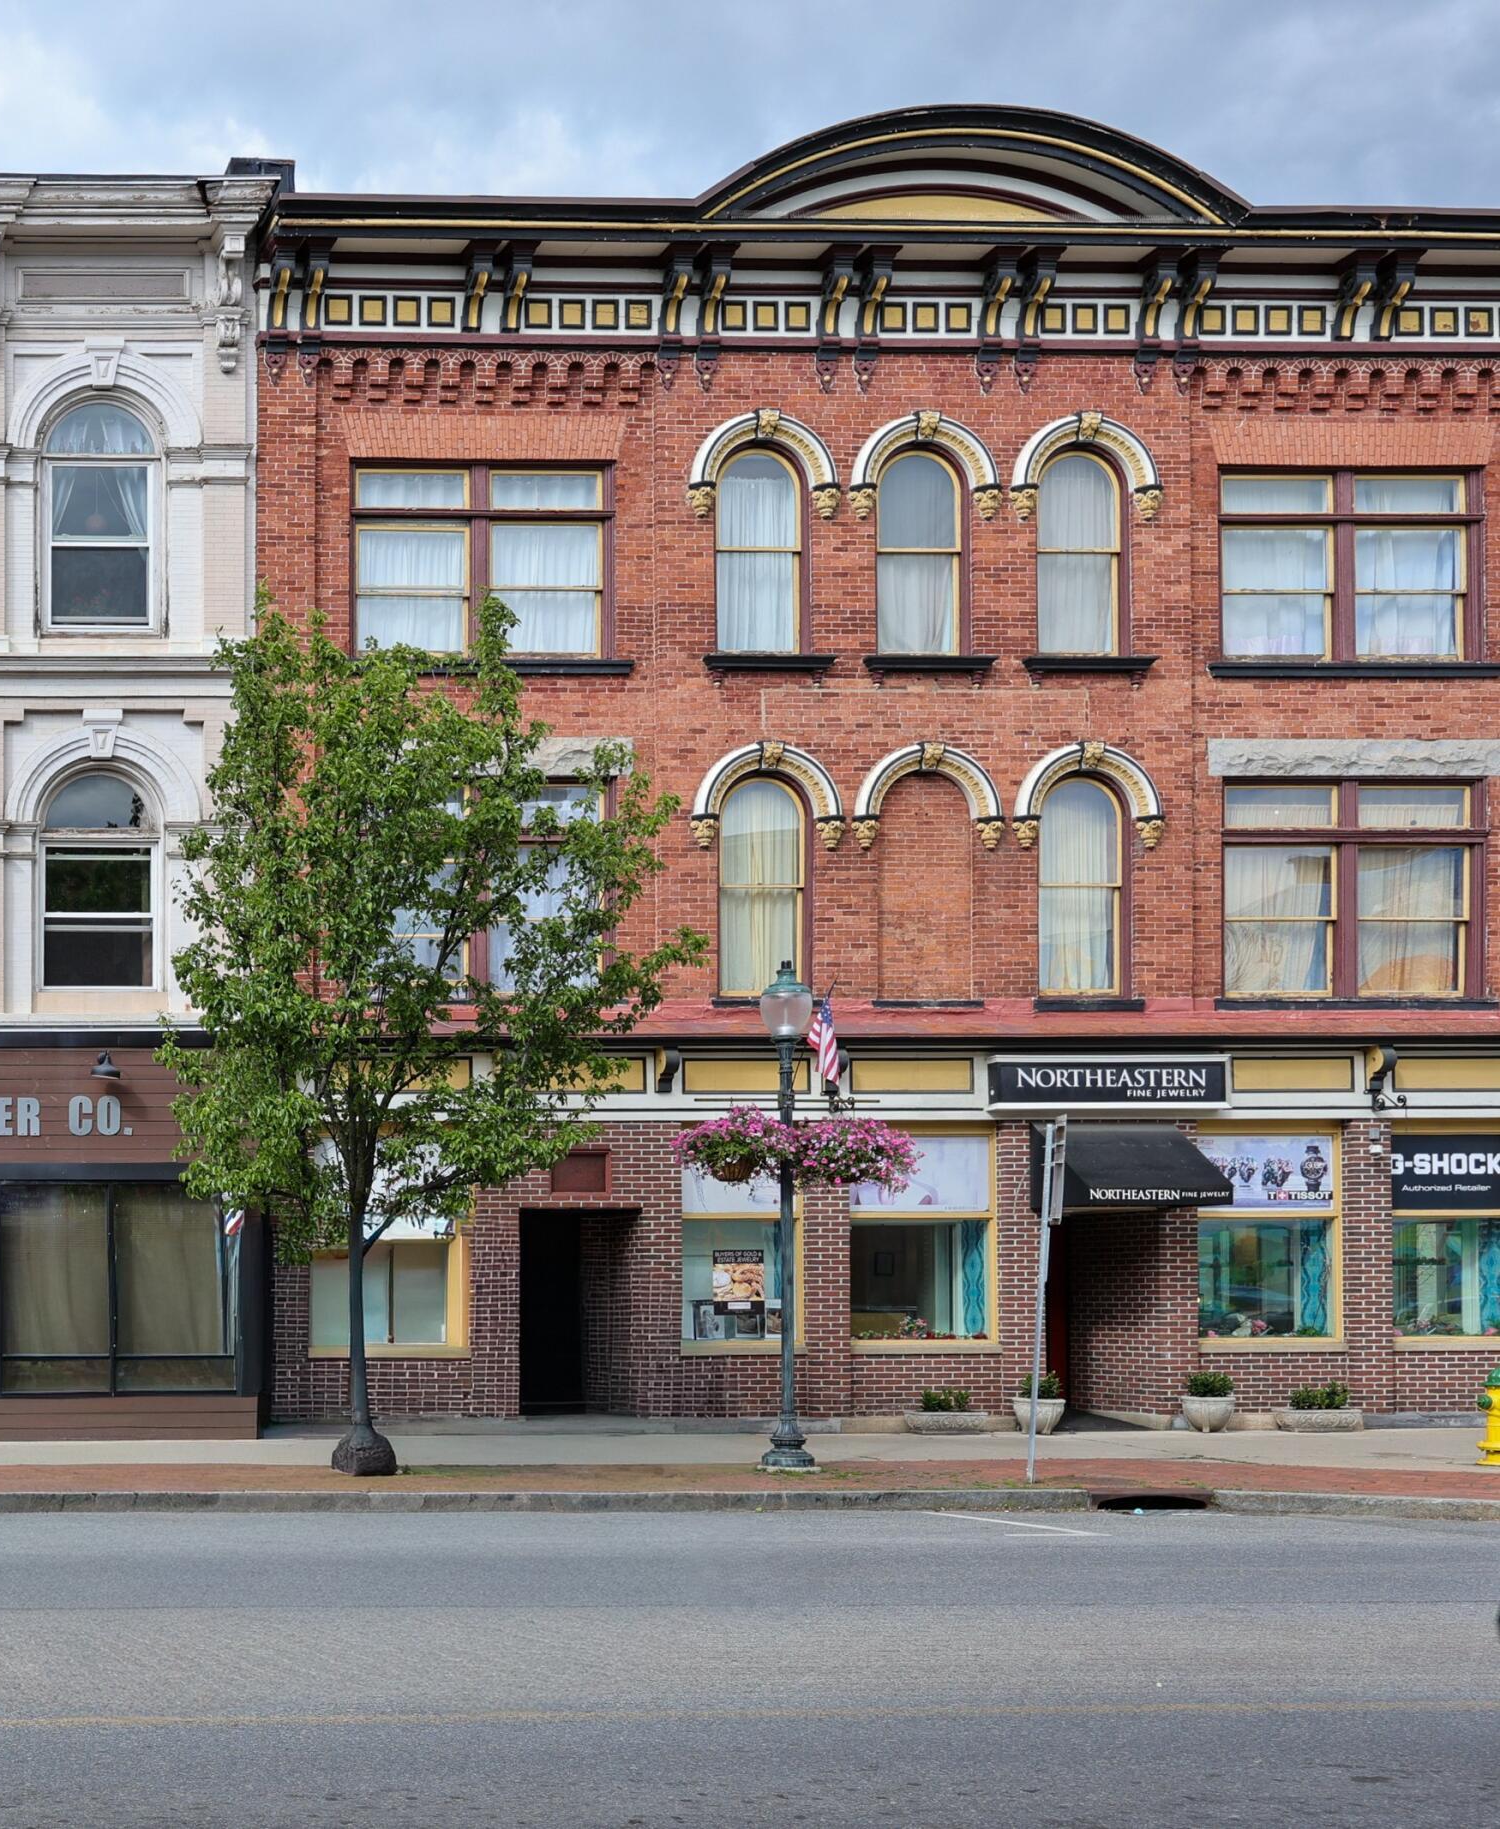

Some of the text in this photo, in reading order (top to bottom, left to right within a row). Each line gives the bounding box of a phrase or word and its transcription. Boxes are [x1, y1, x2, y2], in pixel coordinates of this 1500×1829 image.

[1016, 1067, 1206, 1088] NORTHEASTERN
[1126, 1089, 1206, 1098] FINE JEWELRY
[68, 1095, 133, 1136] CO.
[1391, 1153, 1500, 1175] G-SHOCK
[1089, 1188, 1180, 1200] NORTHEASTERN
[1402, 1184, 1491, 1192] Authorized Retailer
[1289, 1191, 1331, 1199] TISSOT
